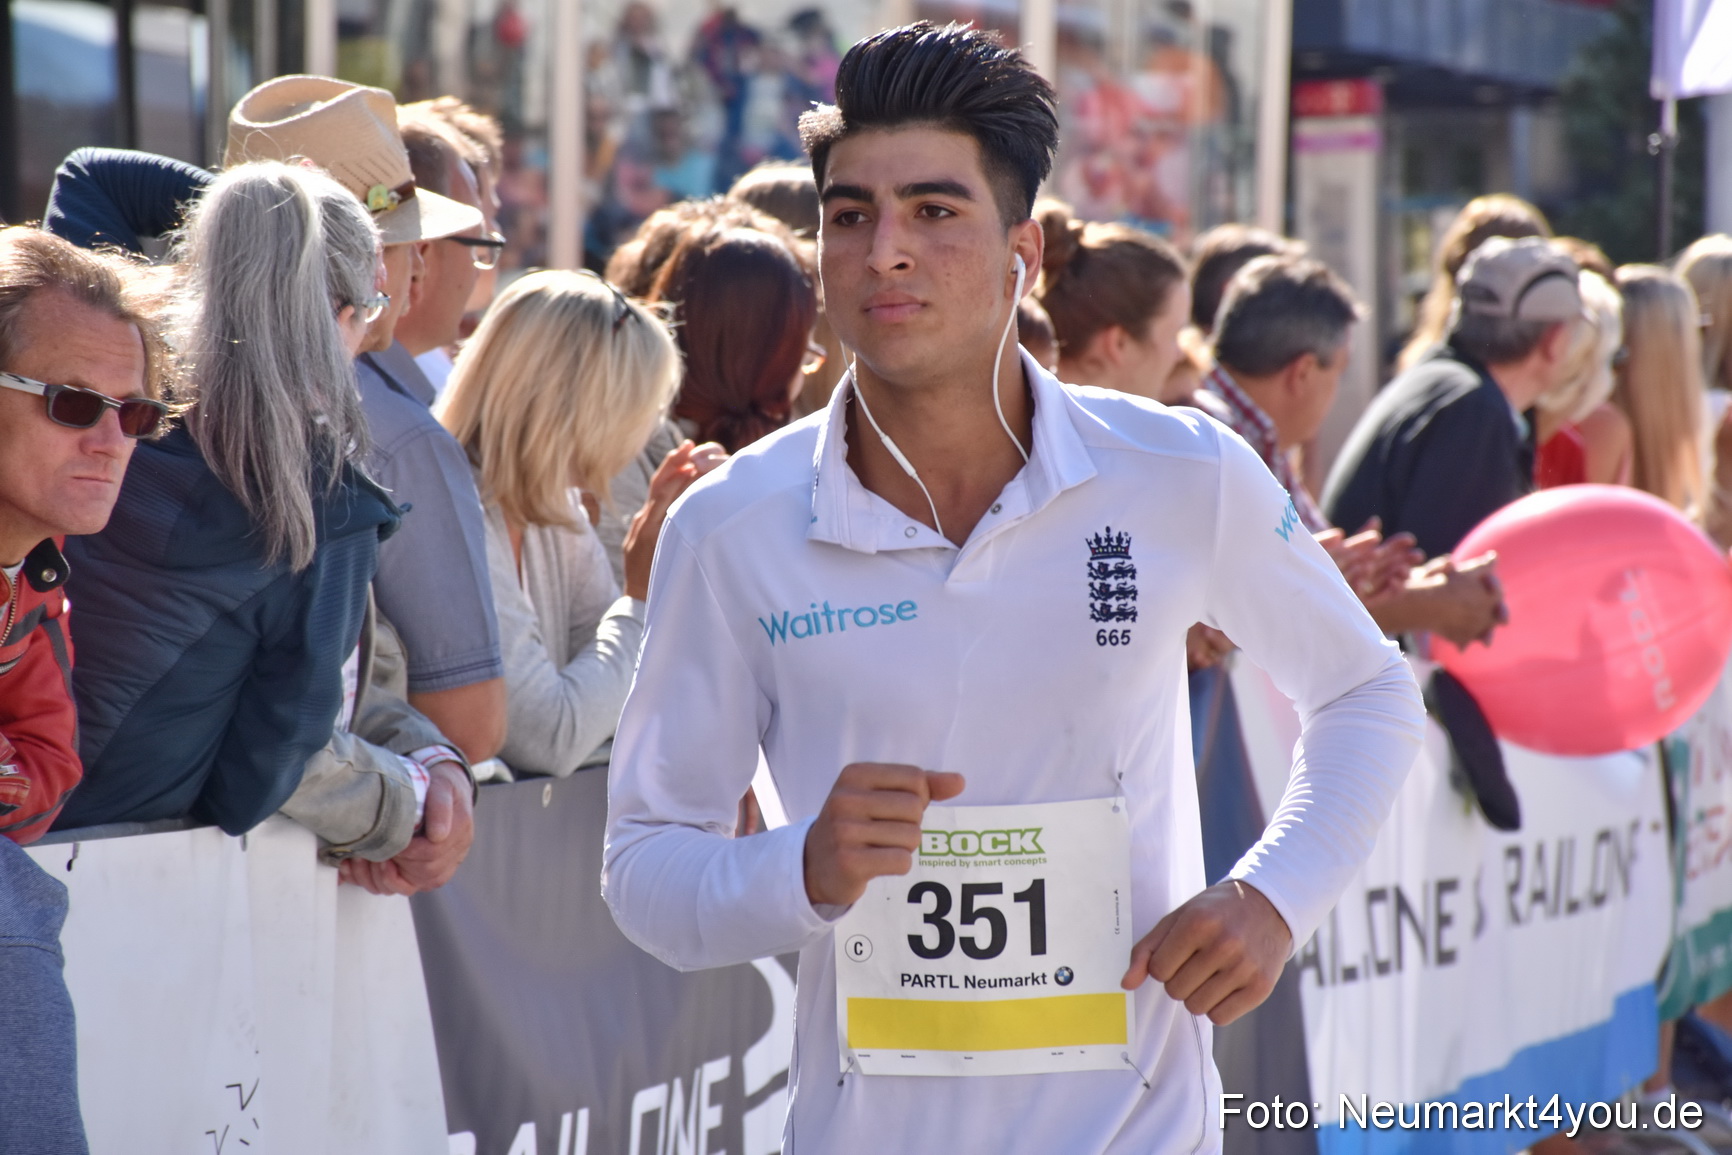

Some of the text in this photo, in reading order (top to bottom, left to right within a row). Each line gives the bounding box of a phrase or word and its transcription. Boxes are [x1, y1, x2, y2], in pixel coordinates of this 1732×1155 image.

[1274, 494, 1298, 543] Wa
[758, 599, 919, 647] Waitrose
[1095, 628, 1132, 647] 665
[918, 827, 1046, 857] BOCK
[918, 856, 1048, 870] inspired by smart concepts
[906, 878, 1048, 960] 351
[900, 972, 960, 989] PARTL
[963, 971, 1048, 989] Neumarkt
